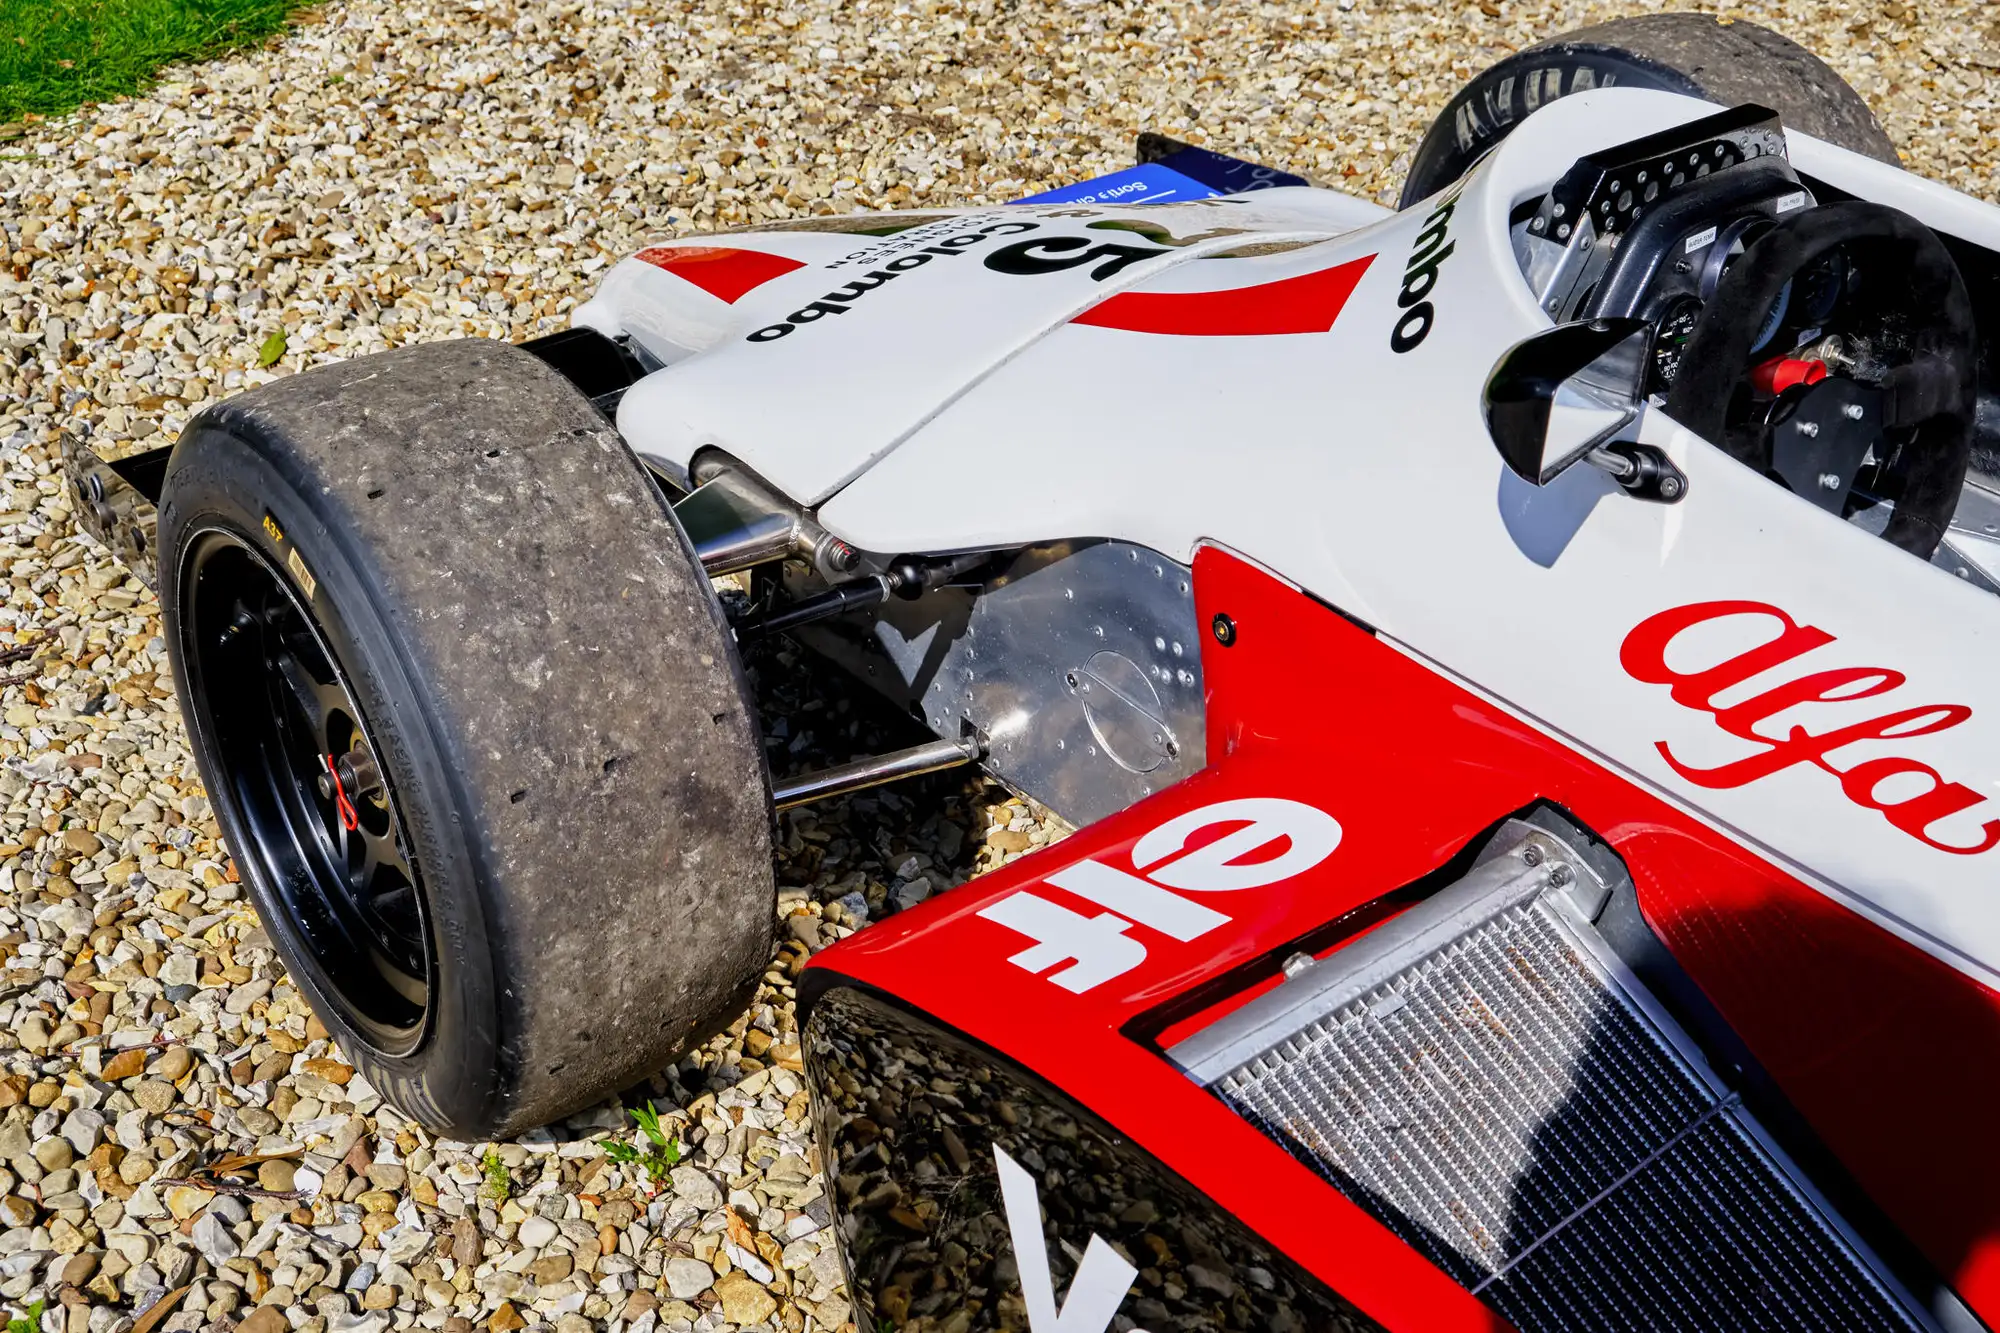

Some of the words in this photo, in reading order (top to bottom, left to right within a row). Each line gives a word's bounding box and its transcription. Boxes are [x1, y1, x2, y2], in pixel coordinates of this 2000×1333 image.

[746, 222, 1041, 342] Colombo
[262, 514, 283, 543] A37
[976, 797, 1342, 995] elf
